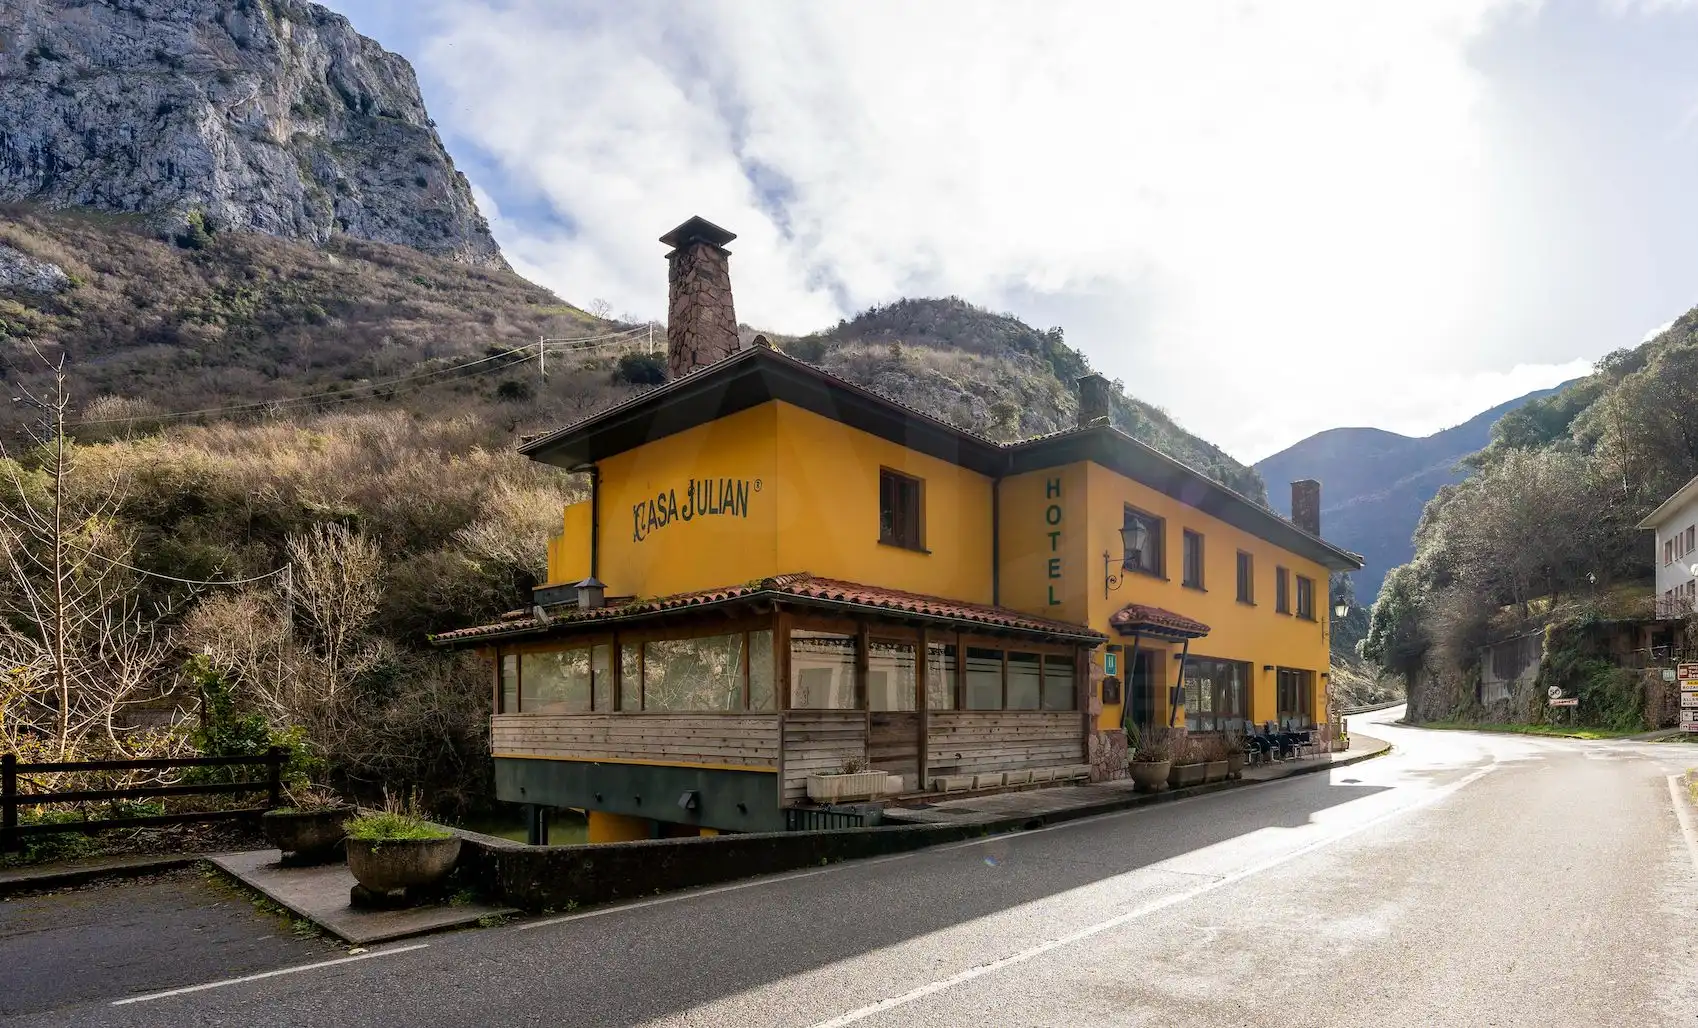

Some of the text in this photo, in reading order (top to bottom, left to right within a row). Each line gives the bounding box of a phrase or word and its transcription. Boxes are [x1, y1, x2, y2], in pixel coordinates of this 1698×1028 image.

[633, 489, 678, 542] CASA
[682, 478, 748, 521] JULIAN
[1046, 478, 1061, 606] HOTEL
